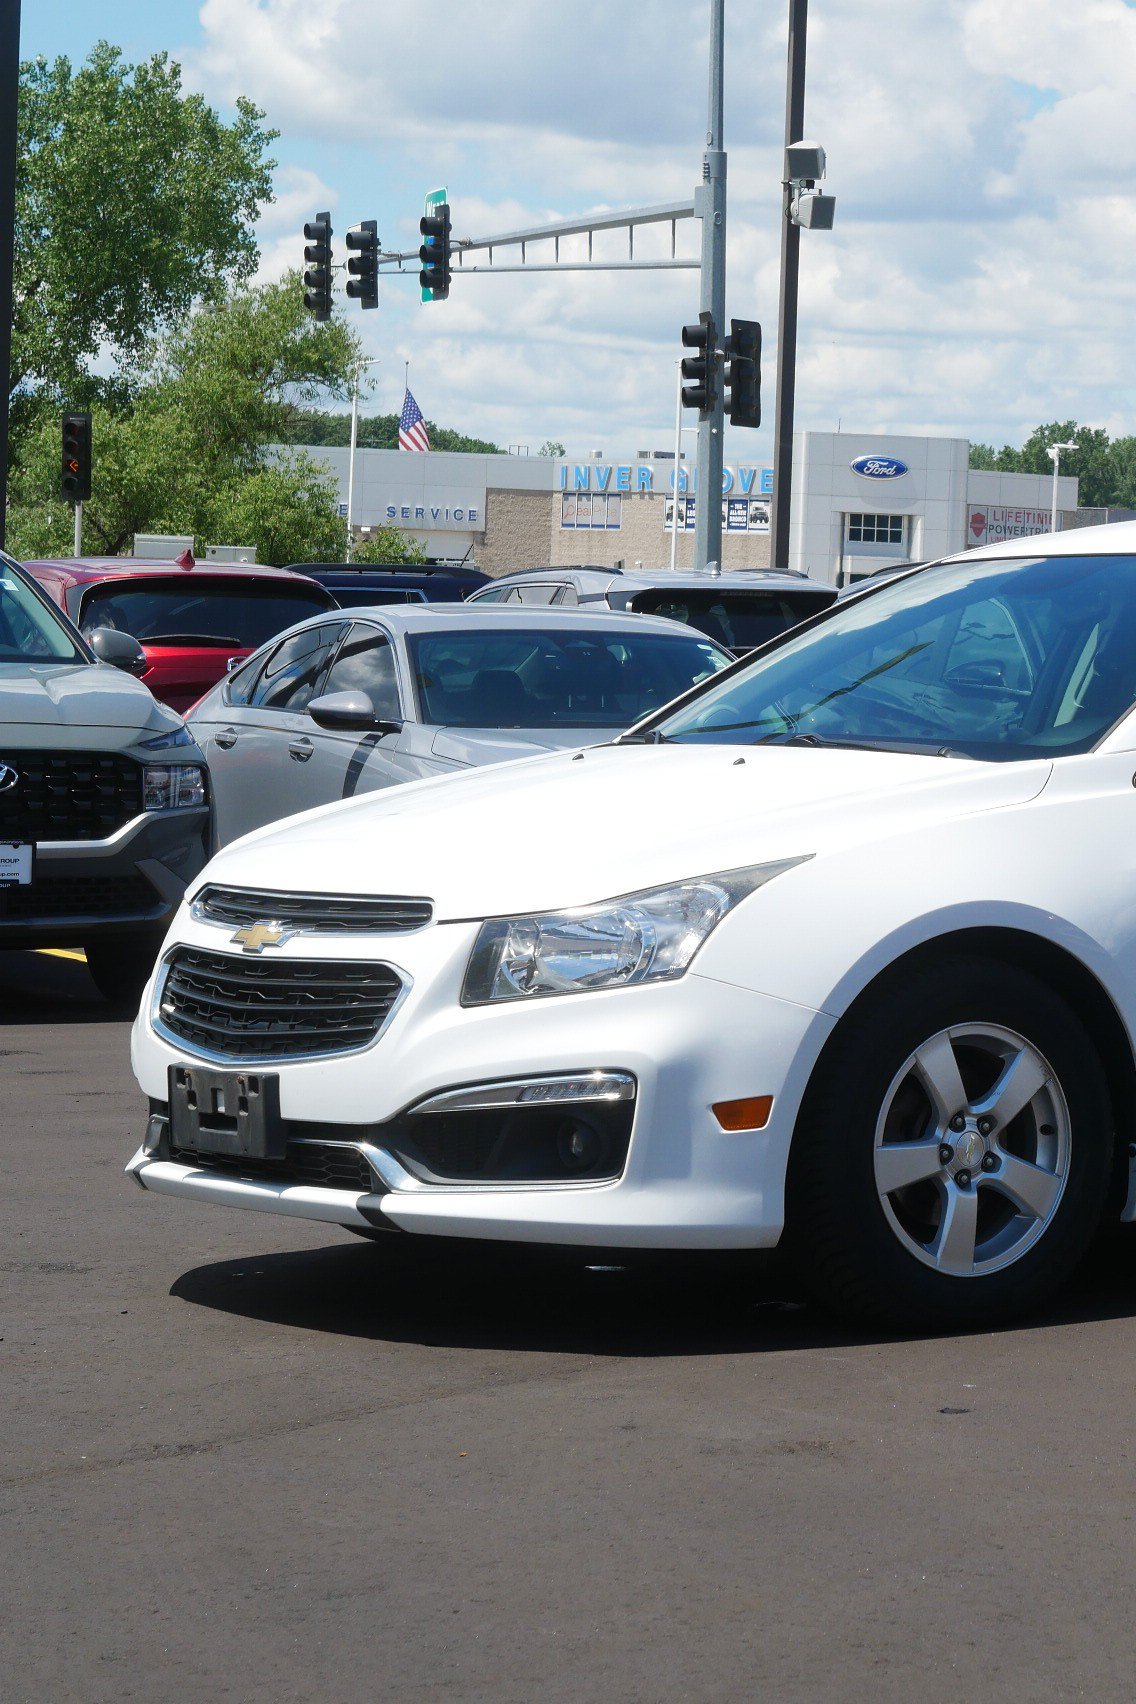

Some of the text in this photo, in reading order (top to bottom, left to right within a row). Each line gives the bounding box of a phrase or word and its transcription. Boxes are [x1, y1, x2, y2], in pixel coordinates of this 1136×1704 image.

[863, 460, 897, 476] Ford
[560, 465, 652, 491] INVER
[386, 505, 477, 521] SERVICE
